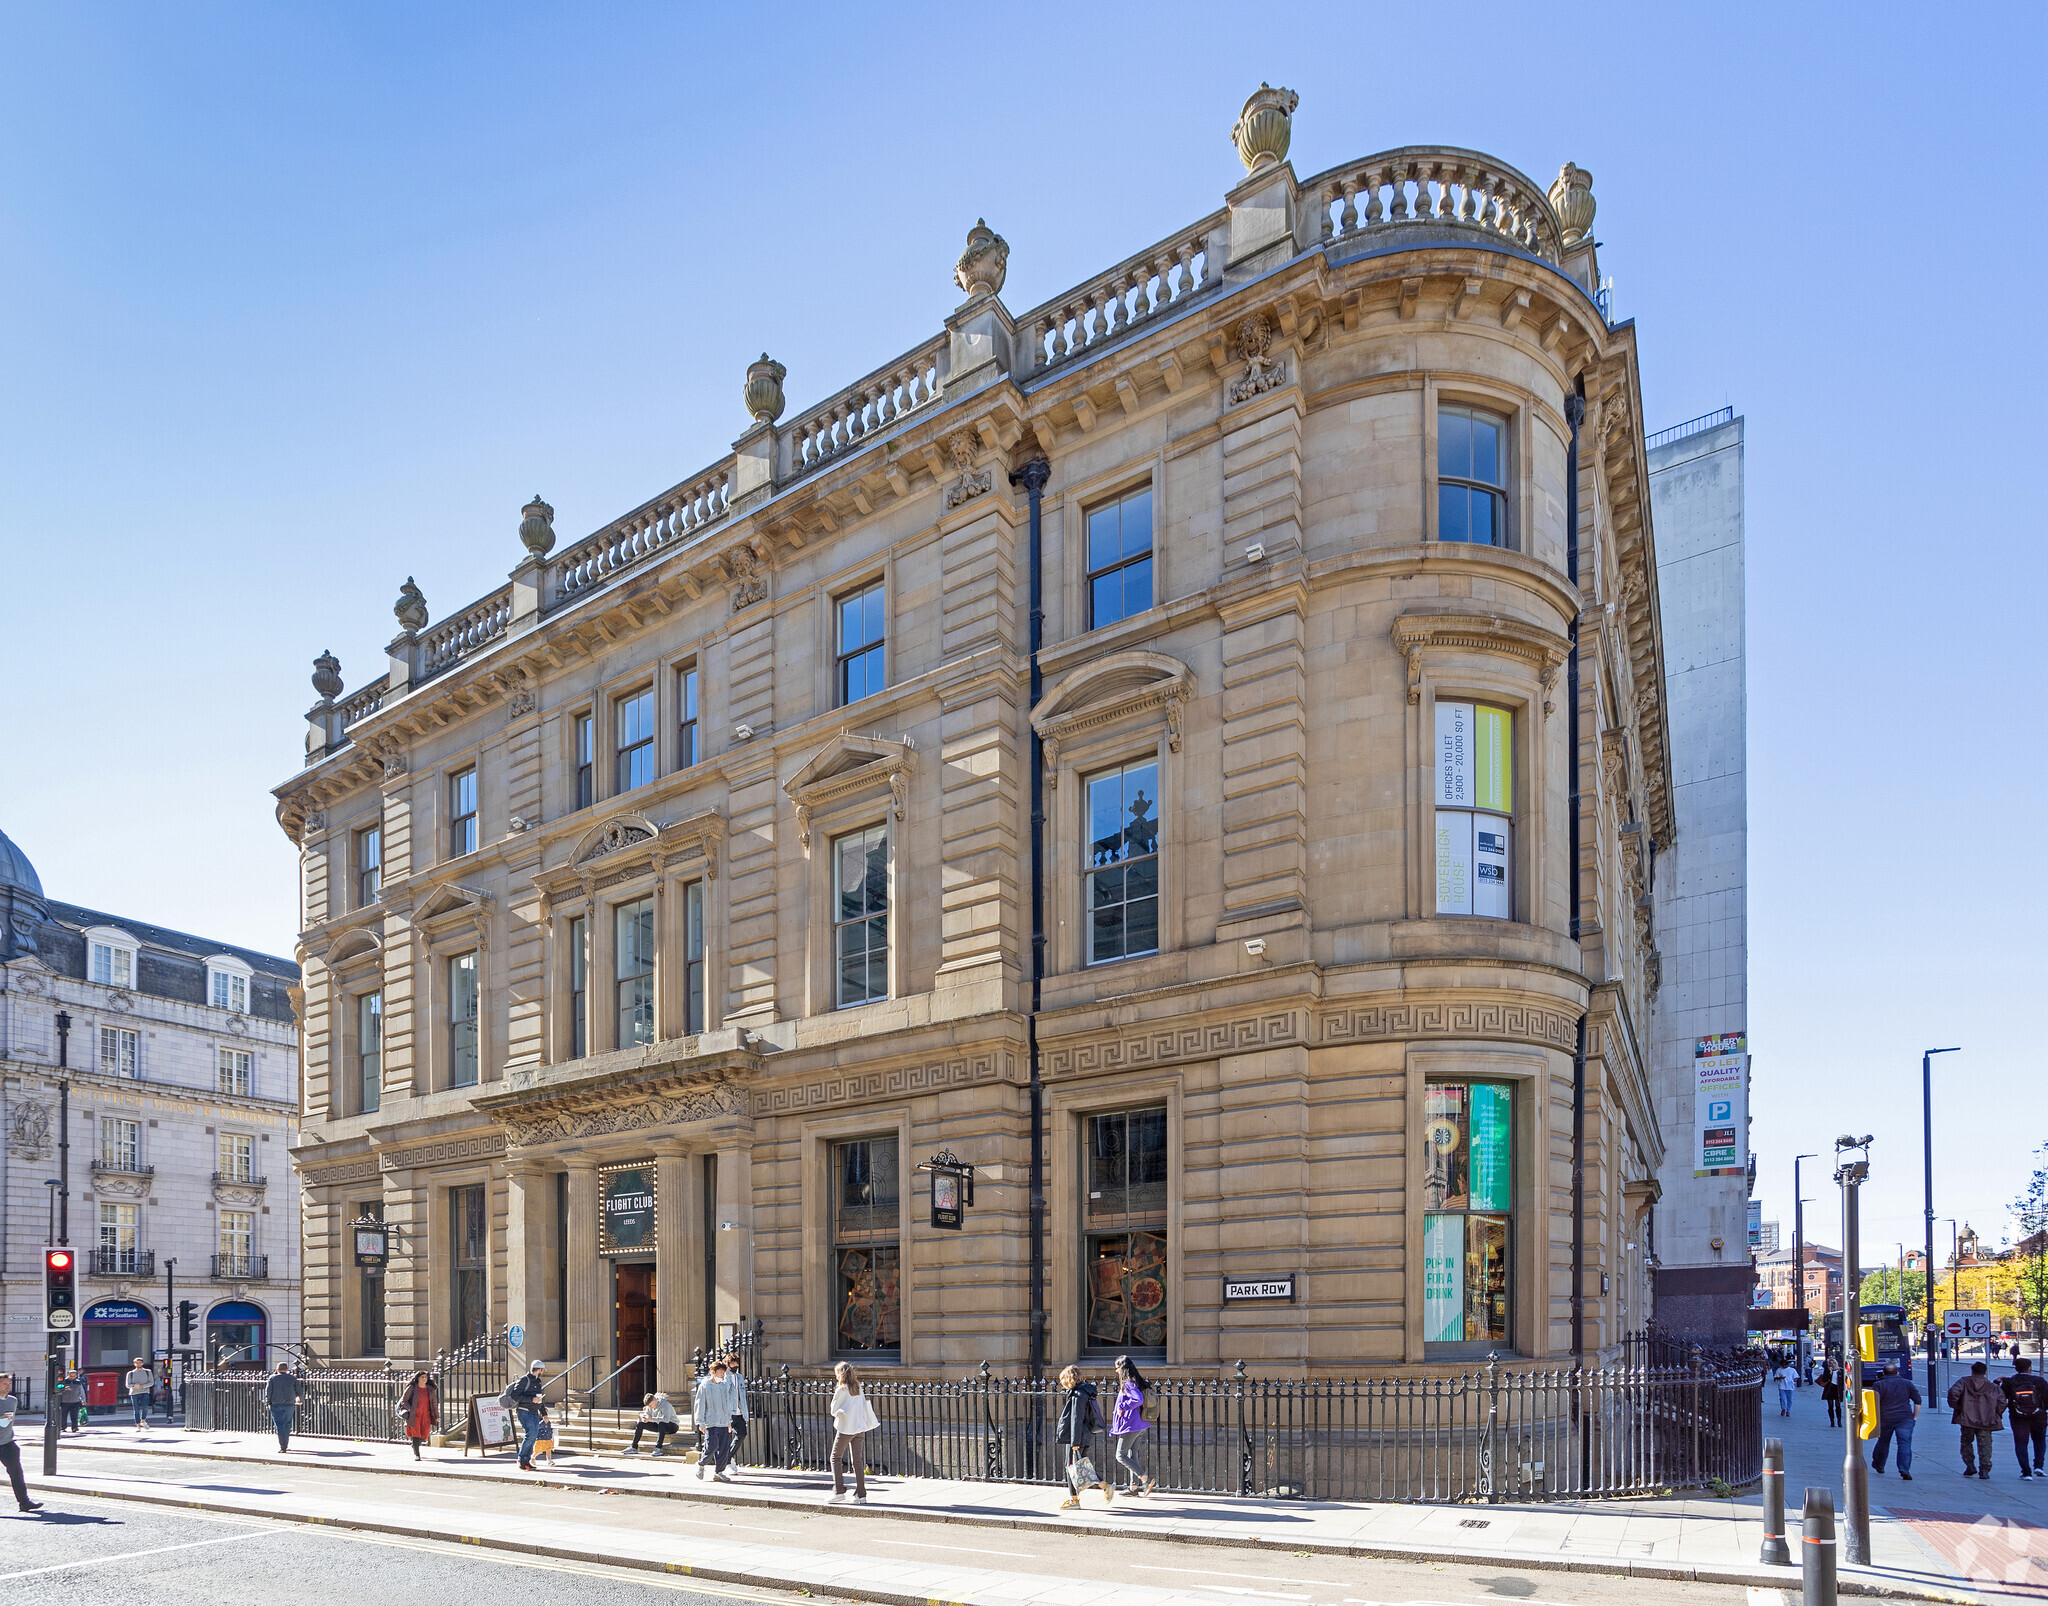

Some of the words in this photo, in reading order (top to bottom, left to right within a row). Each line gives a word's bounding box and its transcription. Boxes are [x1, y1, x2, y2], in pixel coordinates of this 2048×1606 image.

[1455, 708, 1463, 718] FT
[1455, 721, 1464, 733] SQ
[1444, 735, 1453, 750] LET
[1455, 735, 1464, 766] 20,000
[1444, 752, 1453, 763] TO
[1444, 765, 1453, 800] OFFICES
[1456, 776, 1464, 800] 2,900
[1438, 828, 1450, 902] SOVEREIGN
[1479, 864, 1498, 876] wsb
[1454, 861, 1464, 903] HOUSE
[1699, 1037, 1741, 1048] GALLERY
[1704, 1044, 1736, 1052] HOUSE
[1719, 1057, 1740, 1066] LET
[1700, 1067, 1740, 1077] QUALITY
[1700, 1083, 1740, 1092] OFFICES
[71, 1088, 143, 1107] SCOTTISH
[153, 1098, 194, 1114] UNION
[203, 1106, 211, 1116] &
[220, 1108, 279, 1126] NATIONAL
[1712, 1103, 1728, 1119] P
[606, 1198, 632, 1212] FLIGHT
[634, 1196, 652, 1208] CLUB
[1426, 1258, 1442, 1269] POP
[1446, 1257, 1454, 1268] IN
[1427, 1273, 1444, 1284] FOR
[1447, 1273, 1452, 1284] A
[1231, 1286, 1258, 1295] PARK
[1262, 1284, 1286, 1294] ROW
[1426, 1288, 1453, 1299] DRINK
[1849, 1292, 1856, 1300] 7
